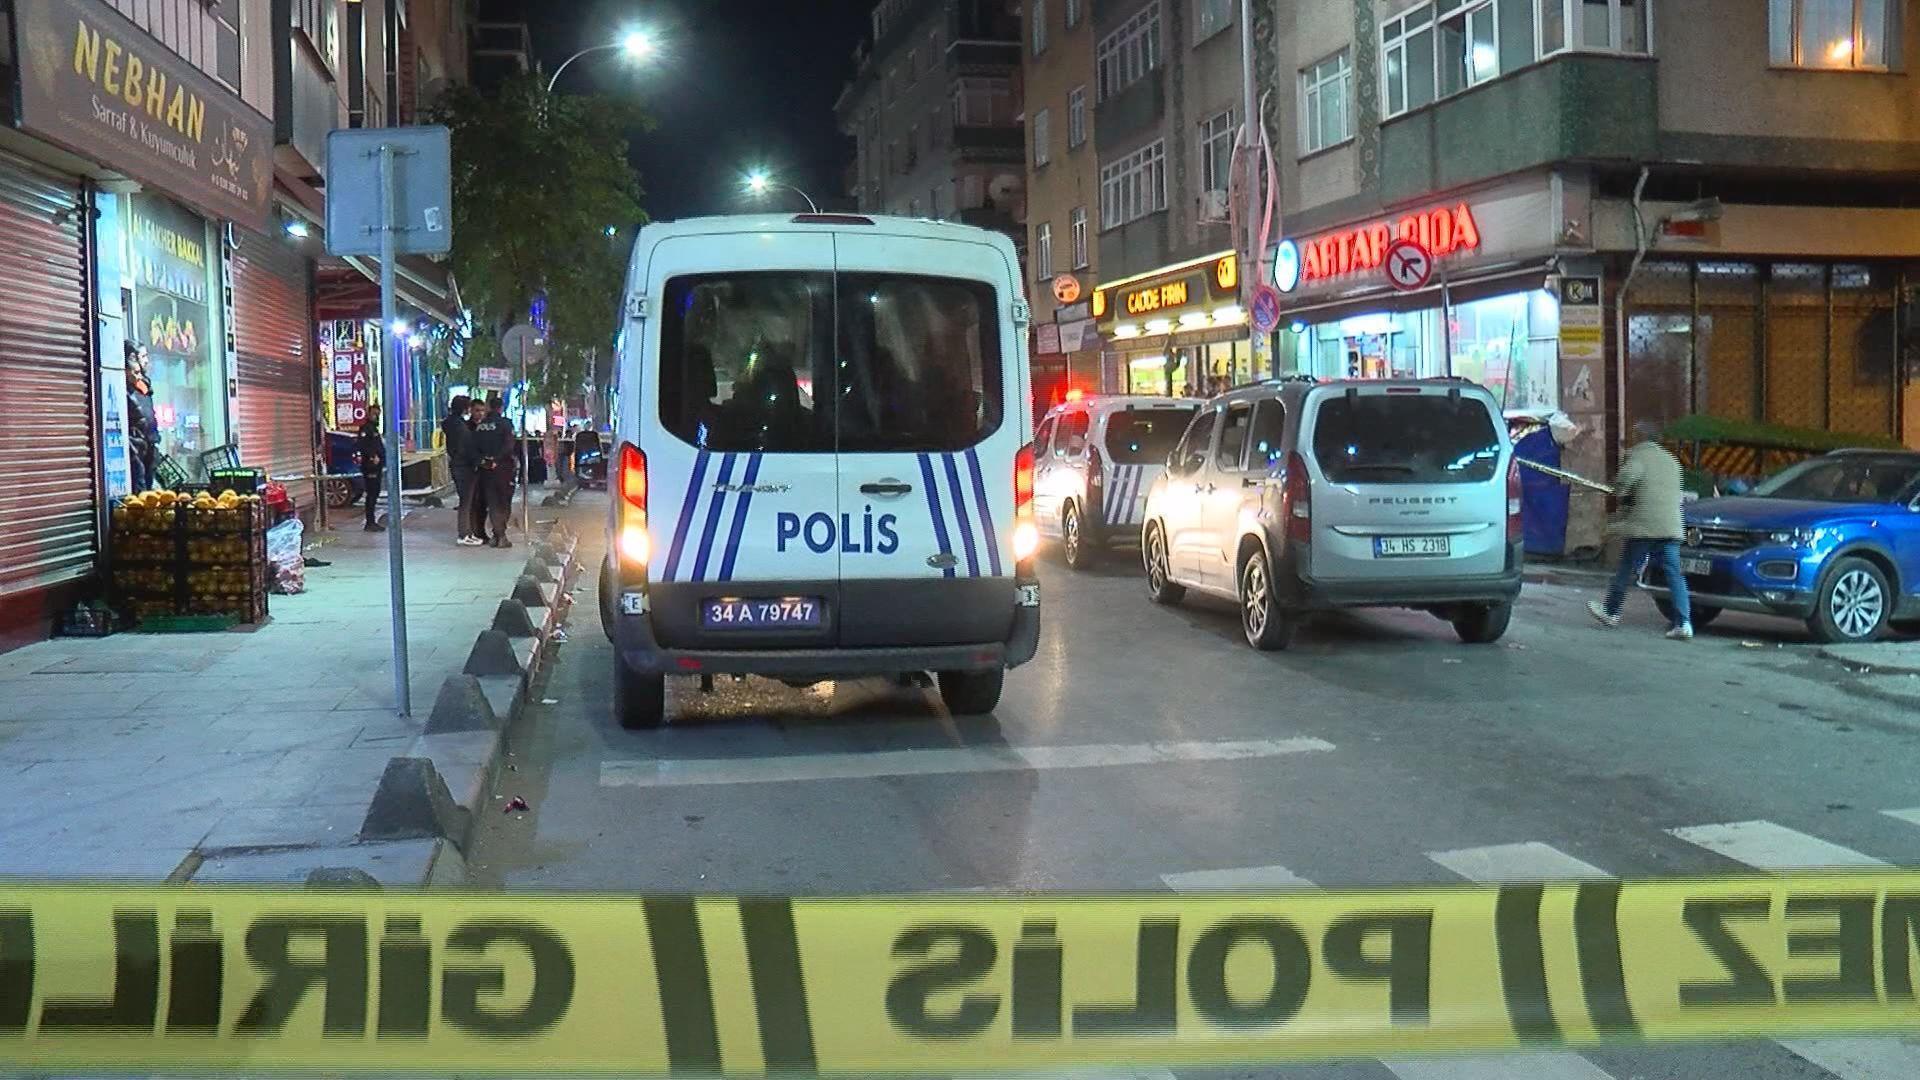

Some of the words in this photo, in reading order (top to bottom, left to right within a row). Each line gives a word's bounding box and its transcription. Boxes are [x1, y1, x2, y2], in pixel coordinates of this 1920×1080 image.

[74, 19, 205, 144] NEBHAN
[92, 94, 127, 134] Sarraf
[129, 115, 137, 140] &
[140, 121, 197, 170] Kuyumculuk
[1369, 496, 1458, 505] PEUGEOT
[776, 503, 899, 555] POLİS
[1382, 539, 1396, 553] 34
[1402, 539, 1415, 552] HS
[1422, 538, 1447, 552] 2318
[711, 605, 734, 623] 34
[738, 605, 753, 622] A
[758, 602, 814, 622] 79747
